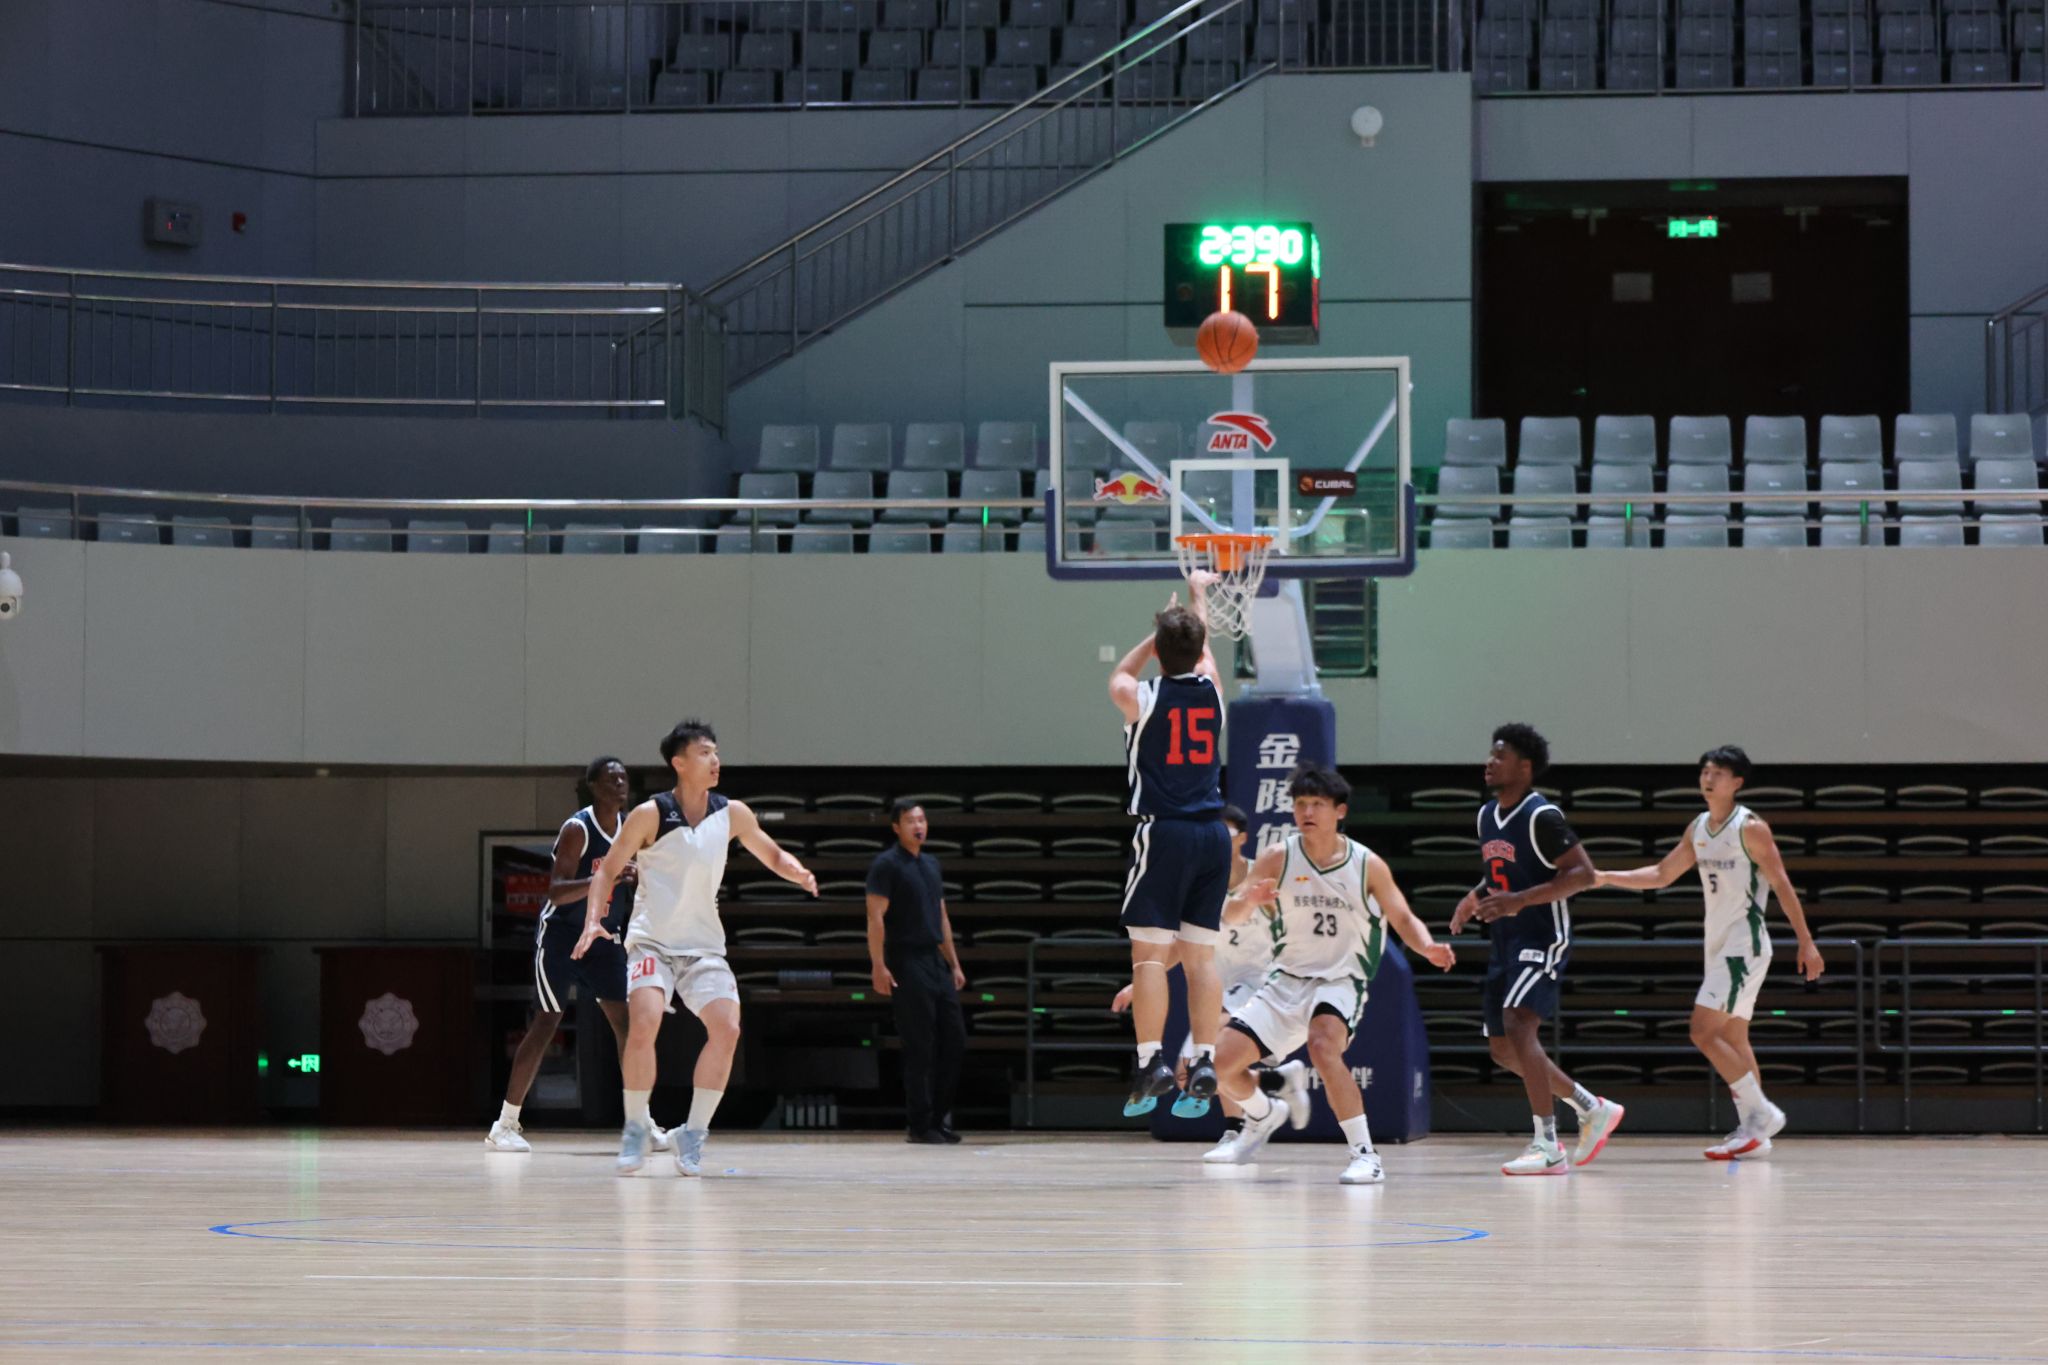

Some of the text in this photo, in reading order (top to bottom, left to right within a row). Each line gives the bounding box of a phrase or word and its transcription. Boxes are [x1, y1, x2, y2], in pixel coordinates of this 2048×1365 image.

[1220, 262, 1279, 320] 17
[1210, 434, 1248, 449] ANTA
[1314, 480, 1354, 489] CUBAL
[1166, 707, 1216, 765] 15
[1490, 859, 1511, 893] 5
[1708, 873, 1718, 893] 5
[1313, 912, 1338, 936] 23
[1229, 929, 1239, 946] 2
[631, 957, 656, 981] 20
